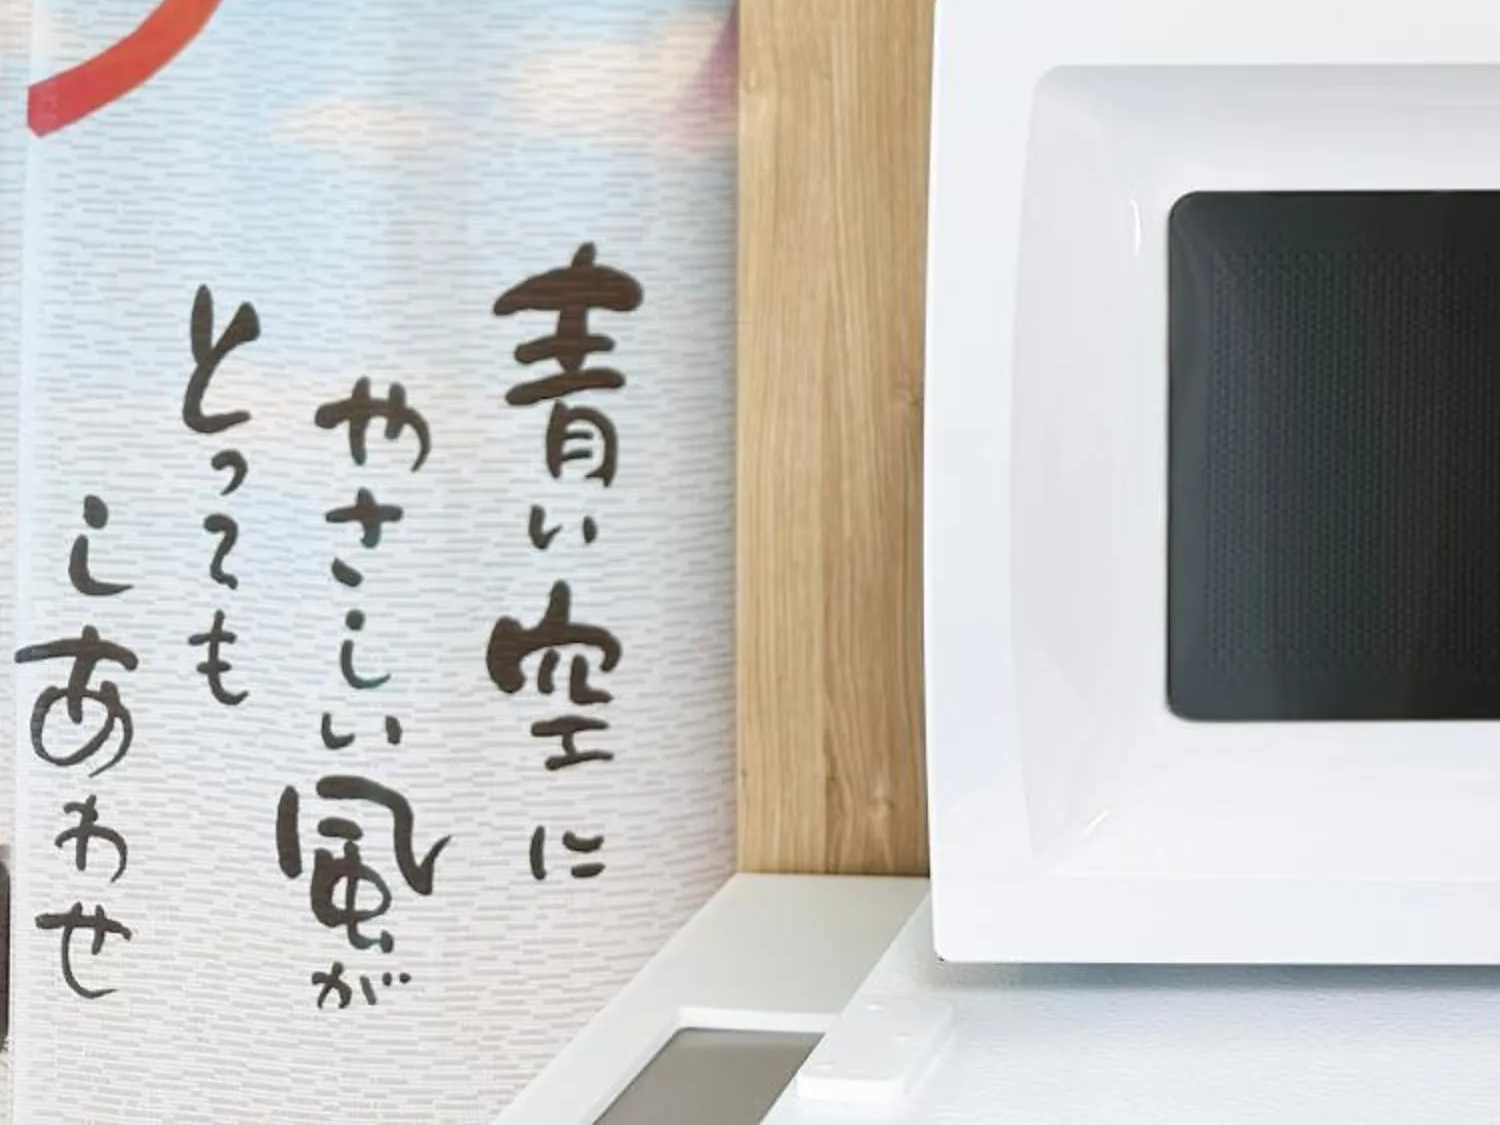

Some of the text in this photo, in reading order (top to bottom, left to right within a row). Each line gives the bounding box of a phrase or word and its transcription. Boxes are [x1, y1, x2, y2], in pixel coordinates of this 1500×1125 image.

[14, 494, 139, 1000] しあわせ
[182, 283, 262, 707] とっても
[276, 376, 452, 1009] やさしい風が
[486, 241, 644, 882] 青い空に
